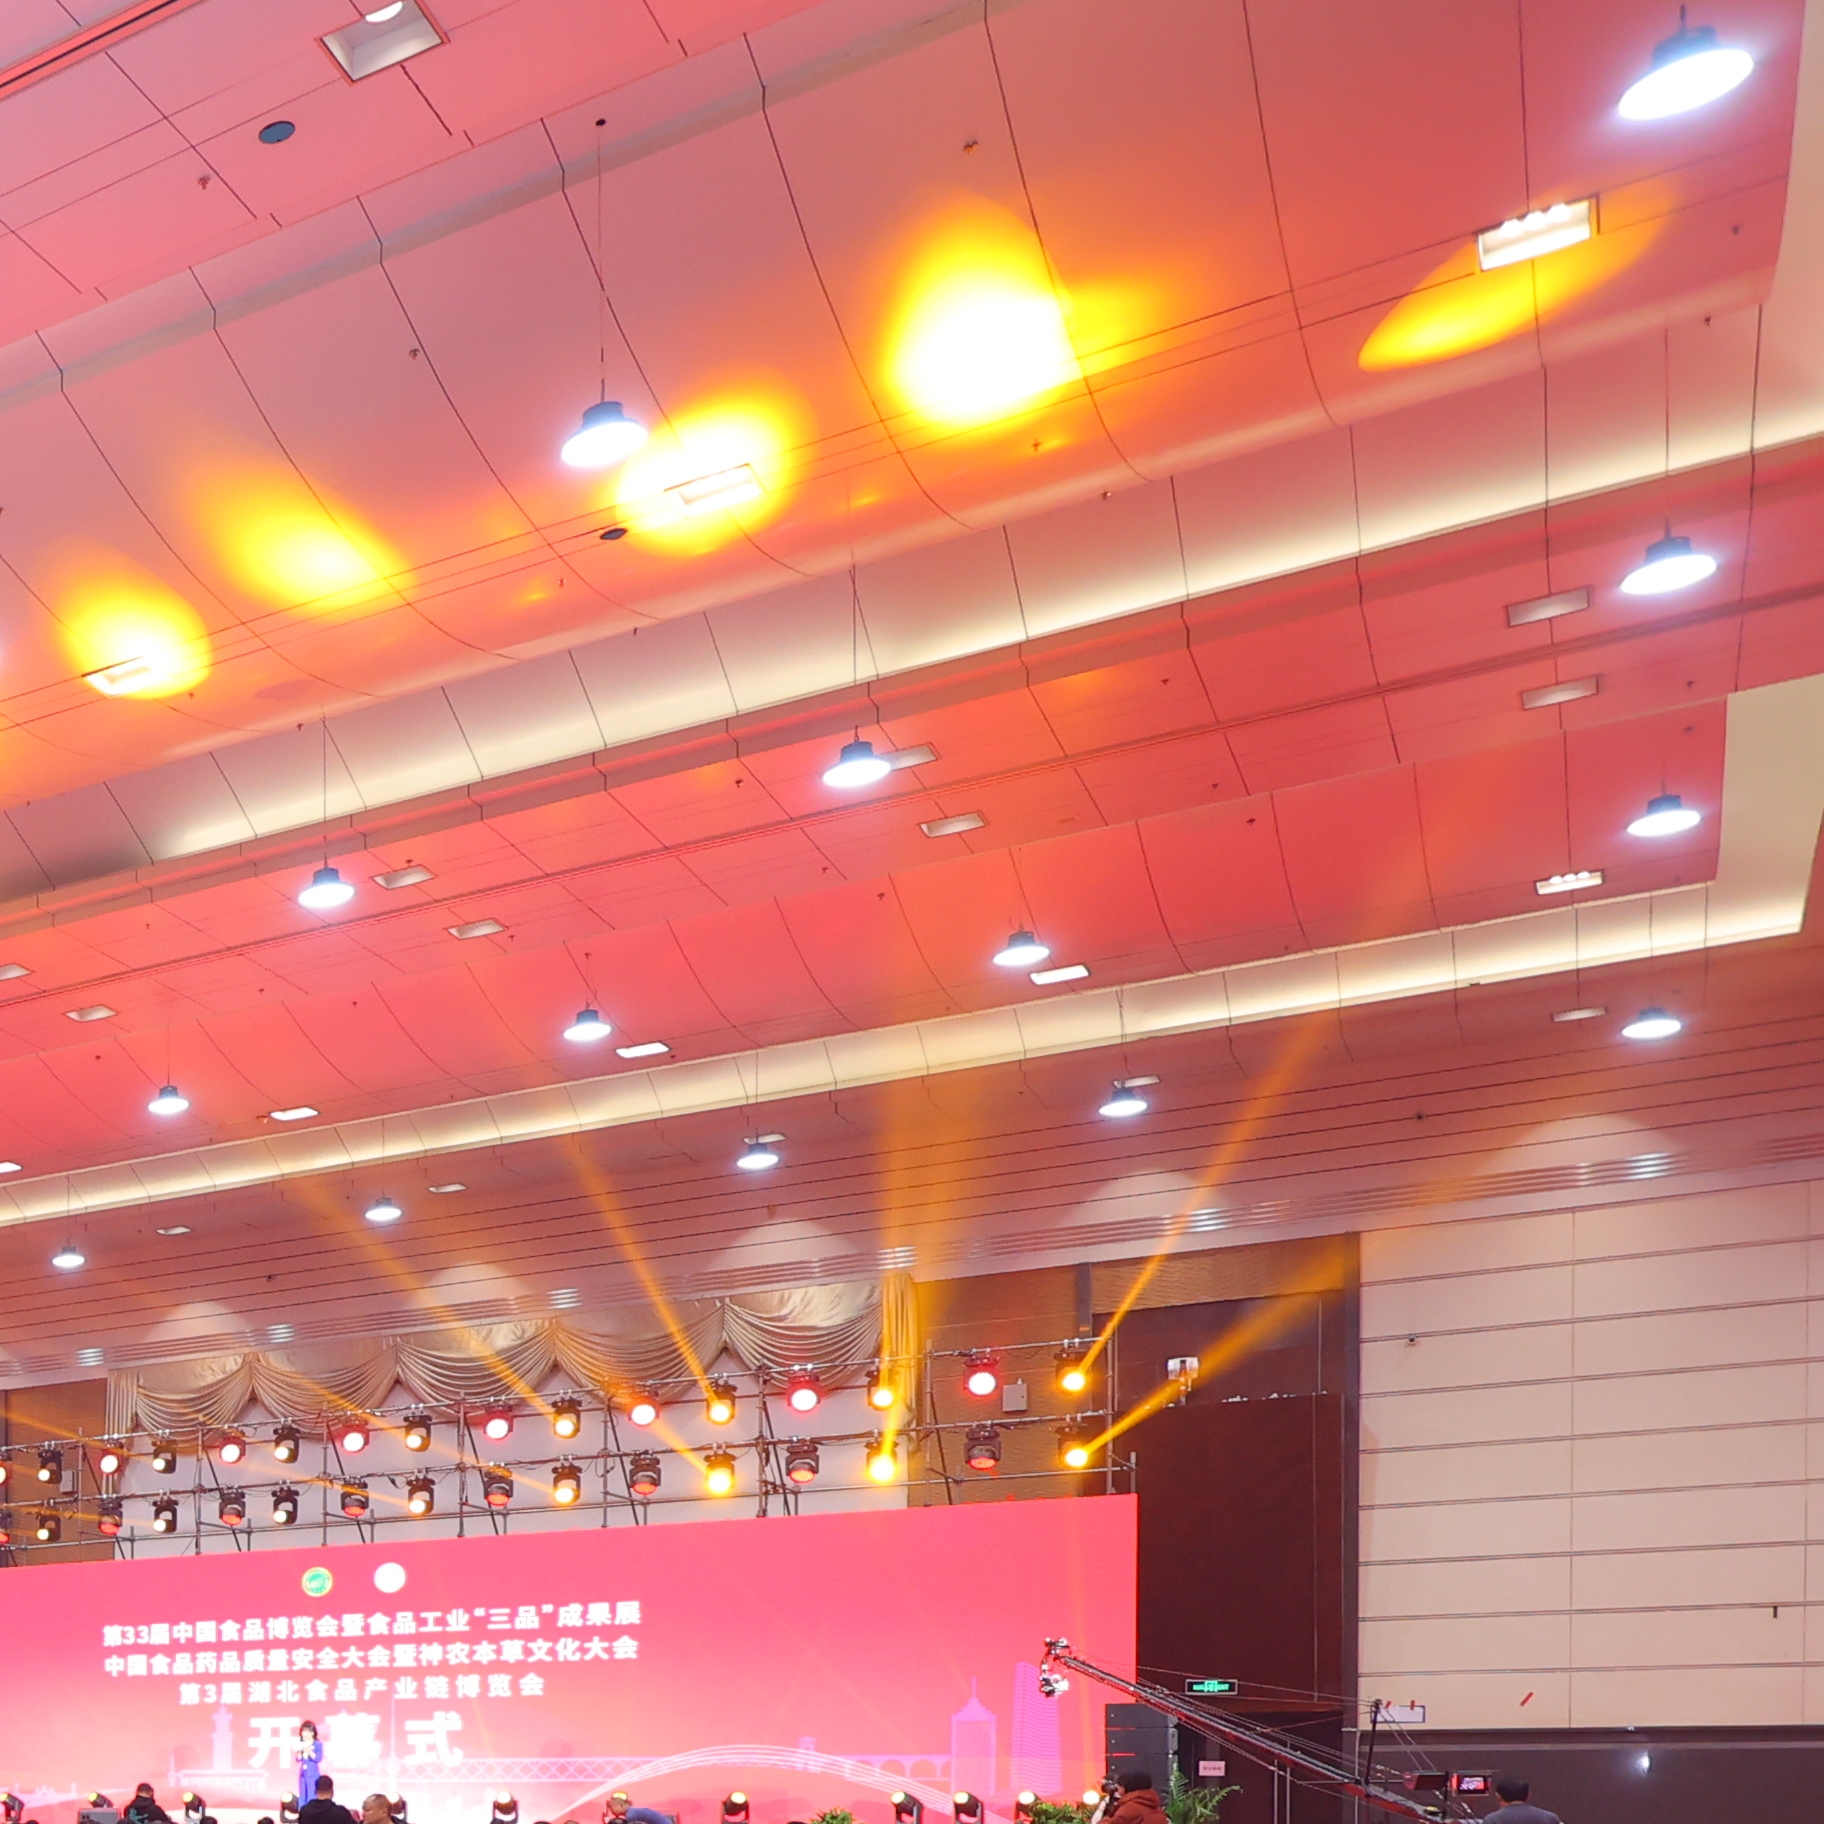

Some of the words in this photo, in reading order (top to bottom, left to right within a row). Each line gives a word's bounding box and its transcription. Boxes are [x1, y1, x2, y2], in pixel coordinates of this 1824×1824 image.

[104, 1636, 639, 1677] 中国食品药品质量安全大会暨神农本草文化大会
[179, 1673, 545, 1705] 第3届湖北食品产业链博览会
[248, 1711, 464, 1769] 开幕式
